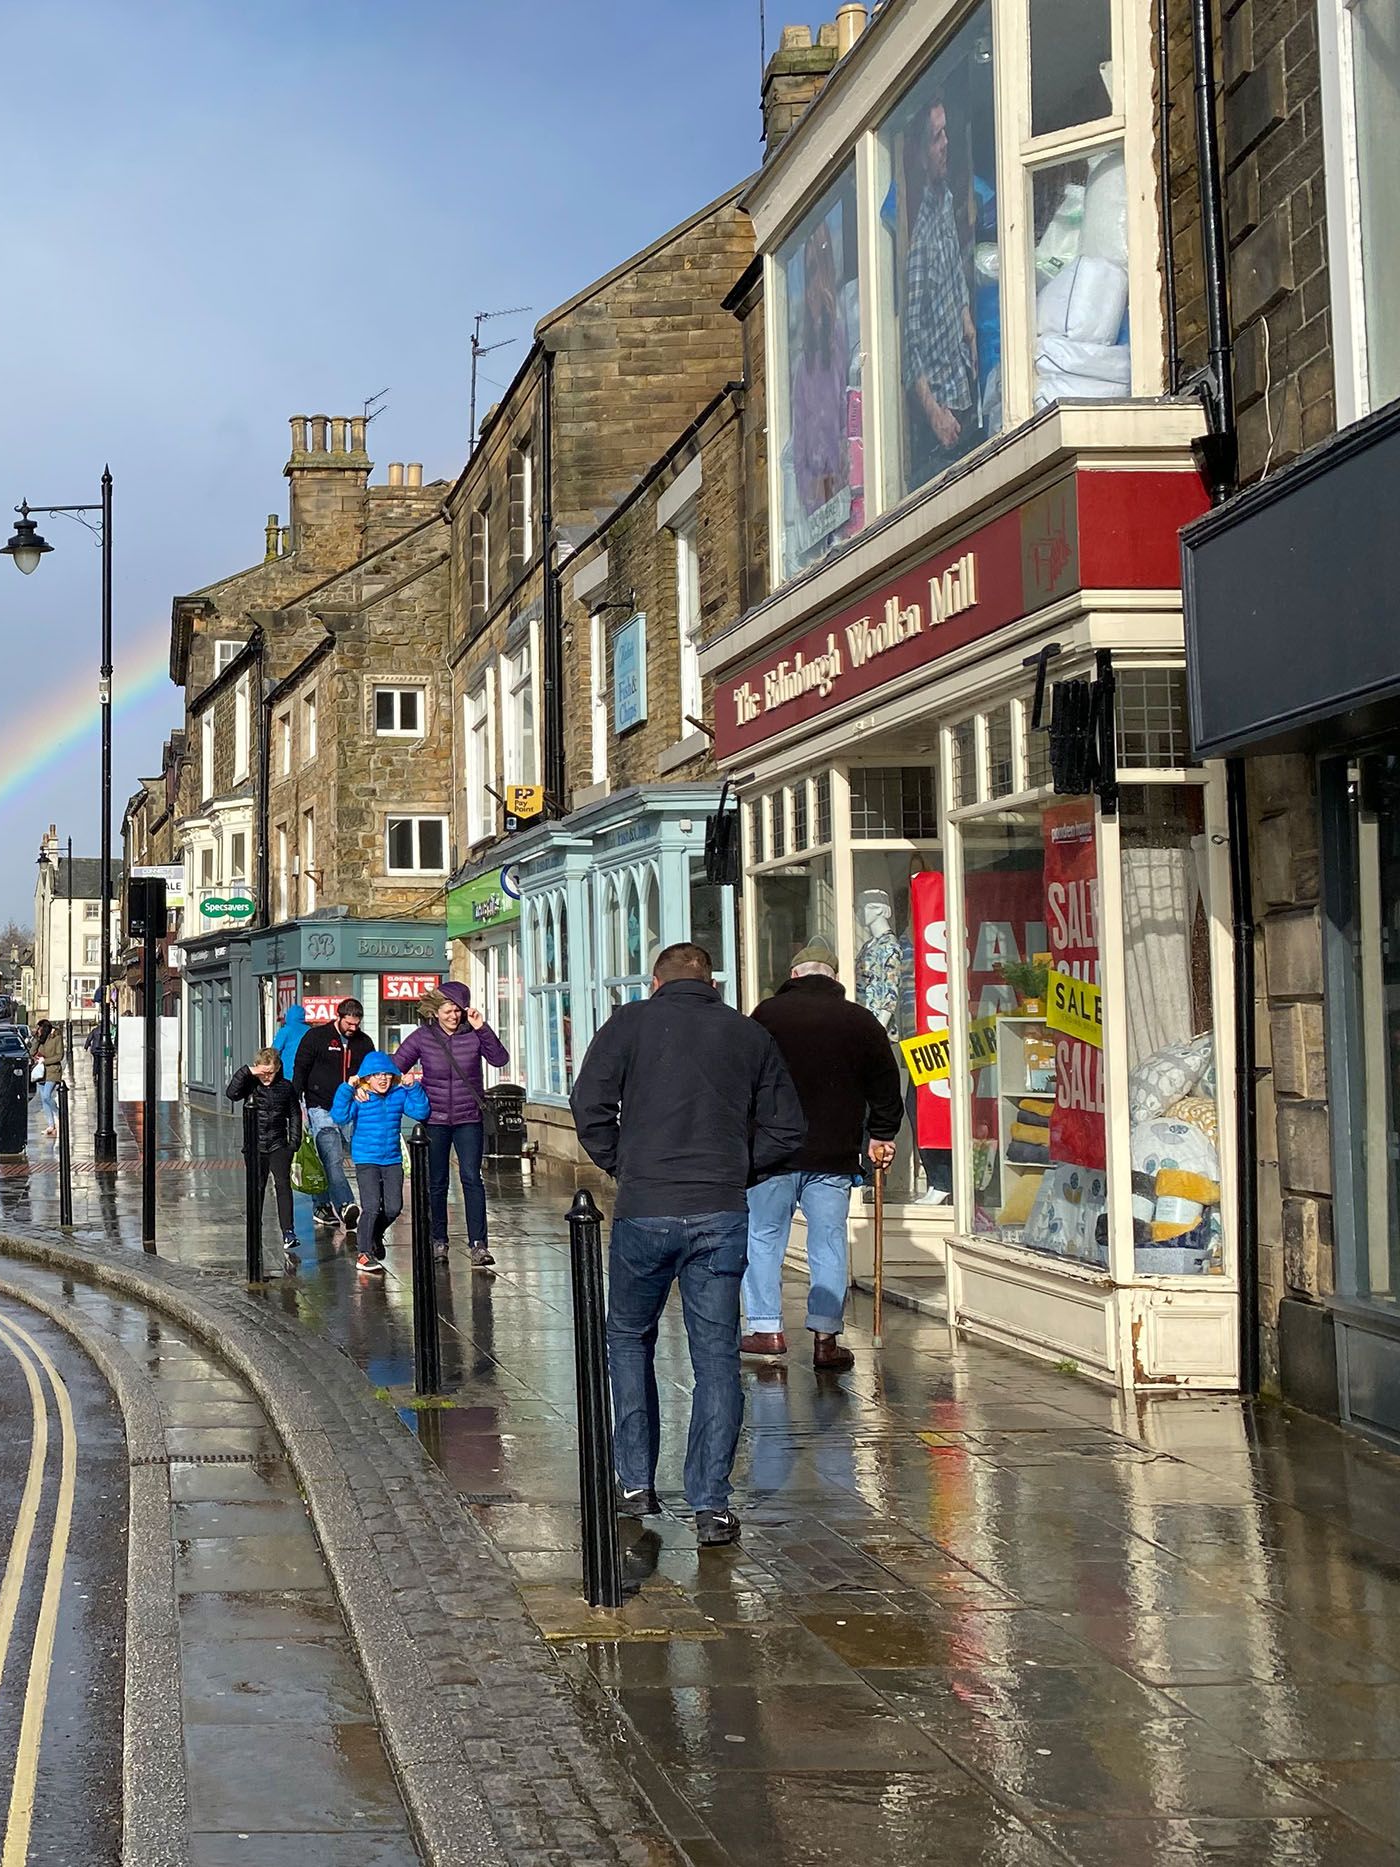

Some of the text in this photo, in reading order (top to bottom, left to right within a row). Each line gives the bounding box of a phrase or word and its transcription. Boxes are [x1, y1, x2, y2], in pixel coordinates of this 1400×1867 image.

[733, 552, 981, 727] The Edinburgh Woollen Mill
[514, 800, 528, 808] Pay
[514, 805, 534, 813] Point
[204, 902, 250, 912] Specsavers
[358, 940, 398, 955] Boho
[1055, 982, 1103, 1025] SALE
[304, 1005, 339, 1020] SAL
